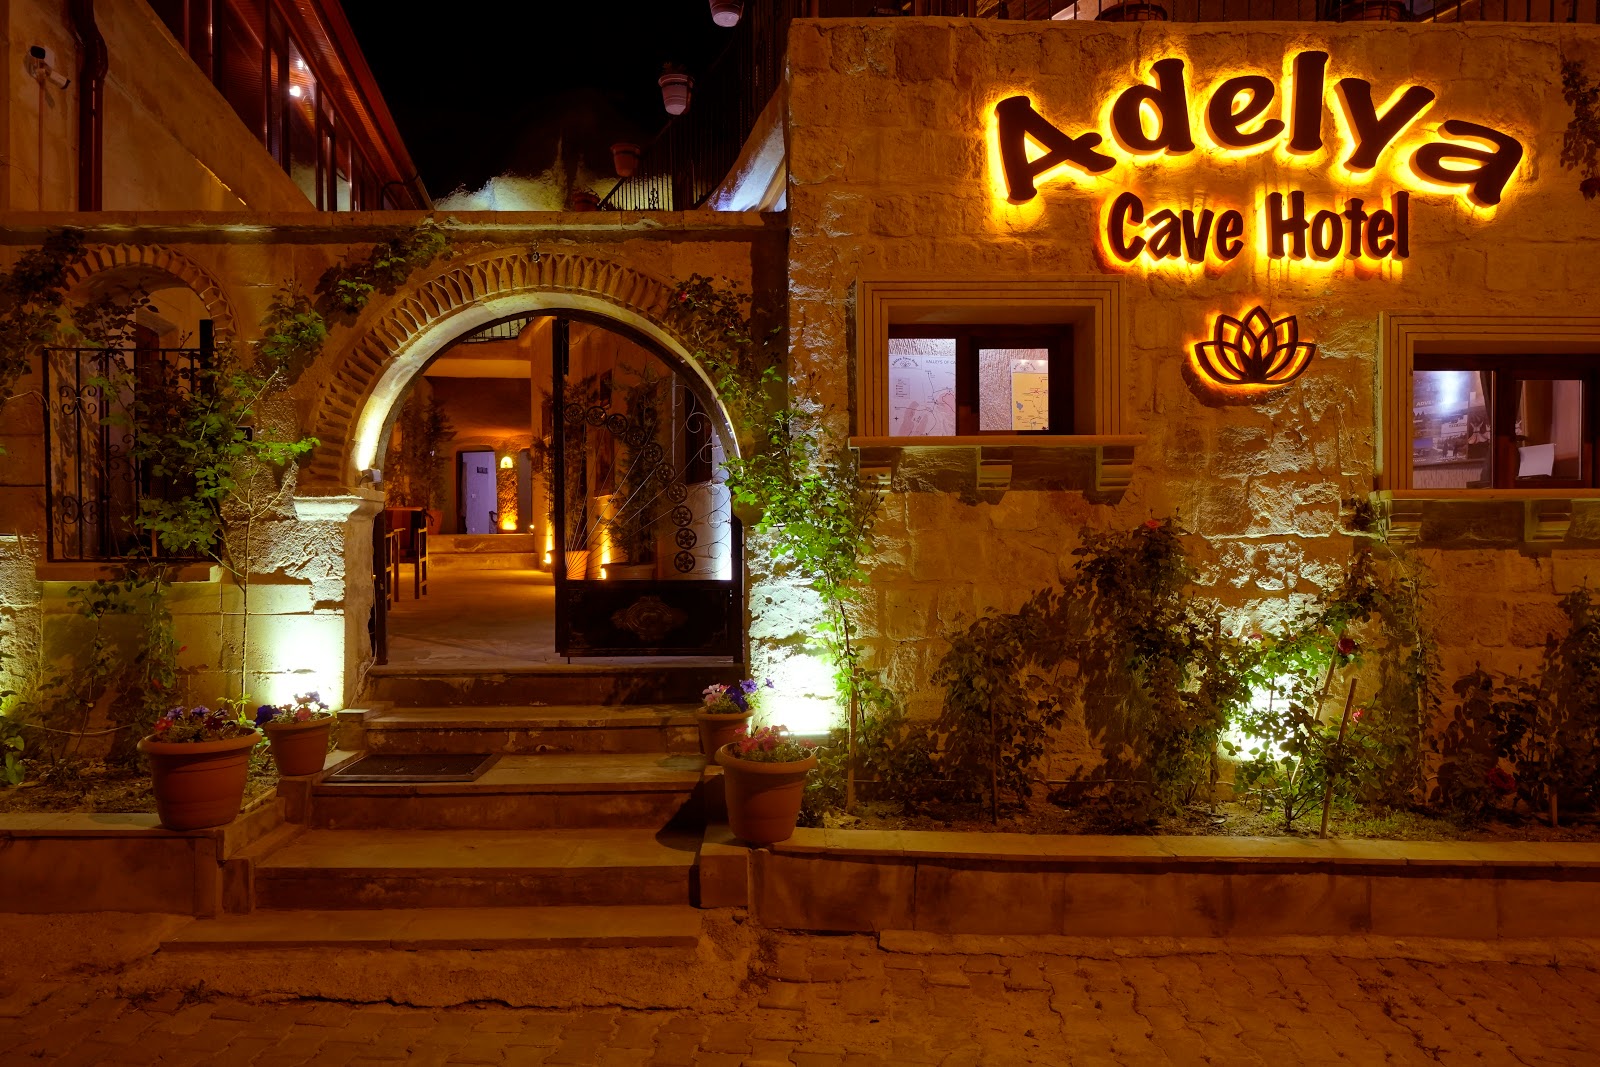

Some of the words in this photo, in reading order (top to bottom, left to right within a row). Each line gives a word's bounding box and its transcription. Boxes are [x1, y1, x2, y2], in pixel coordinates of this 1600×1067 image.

[995, 50, 1523, 206] Adelya
[1106, 191, 1244, 263] Cave
[1265, 190, 1410, 261] Hotel
